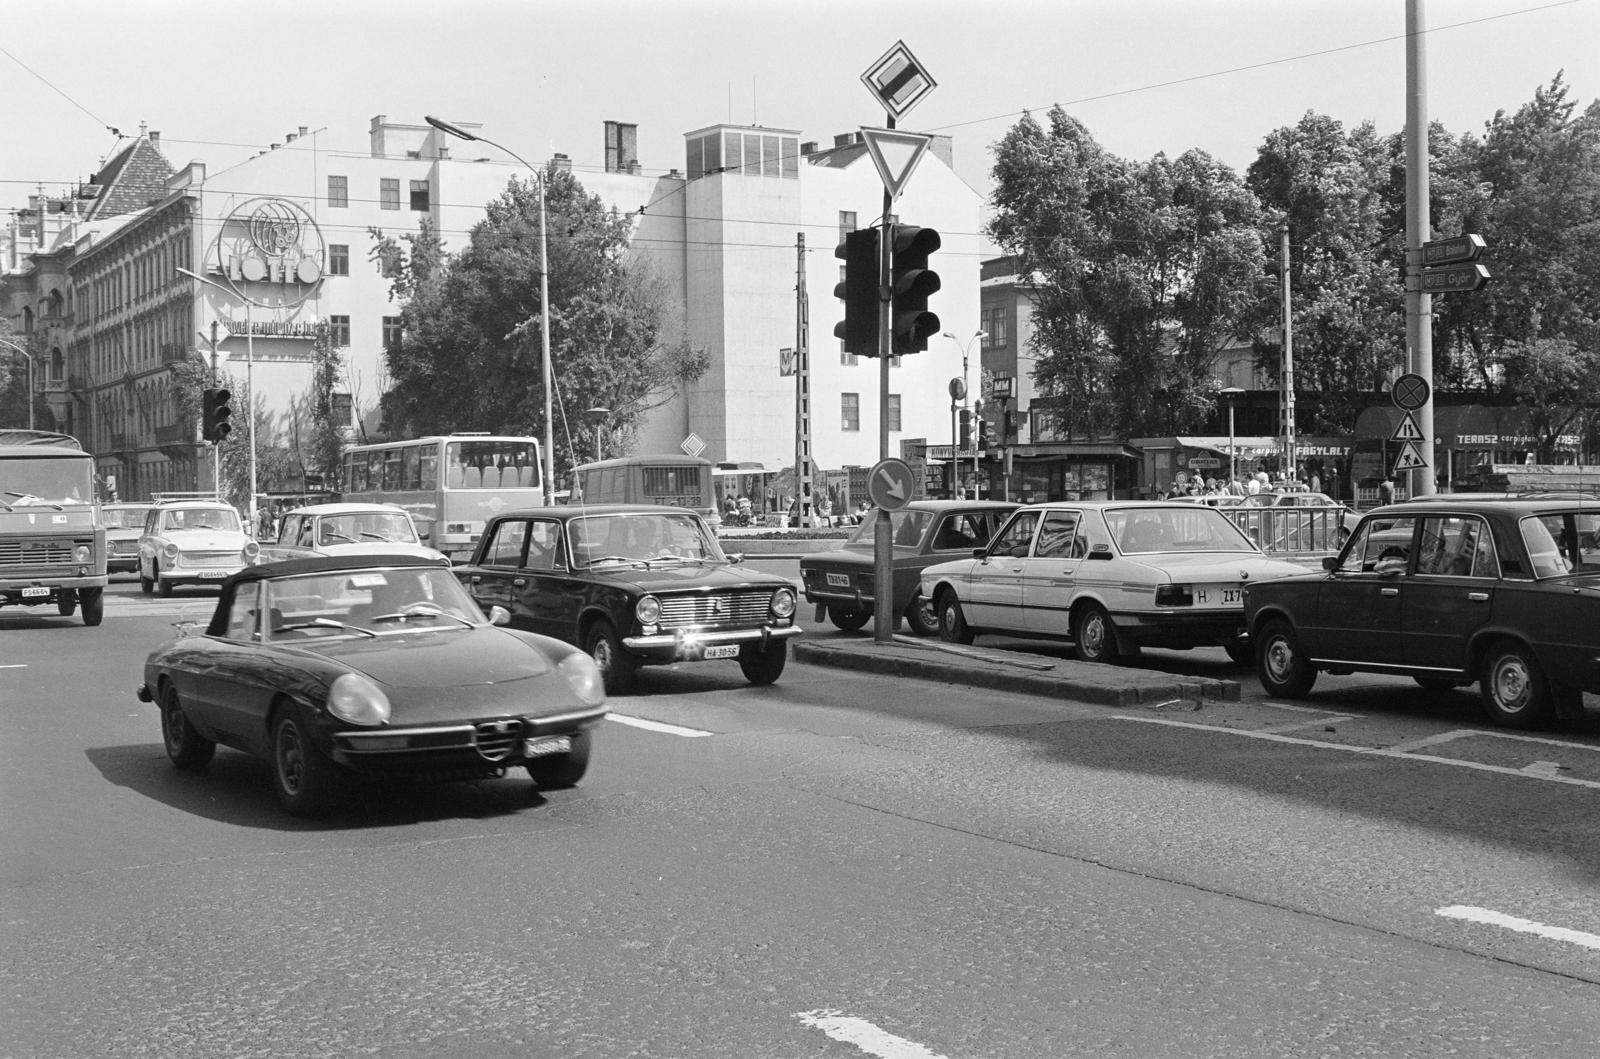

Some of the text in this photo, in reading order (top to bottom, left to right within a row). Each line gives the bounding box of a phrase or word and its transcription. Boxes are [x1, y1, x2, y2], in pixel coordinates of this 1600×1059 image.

[229, 255, 321, 284] LOTTO
[1295, 446, 1351, 456] FAGYLALT
[1198, 590, 1243, 603] H ZX-7
